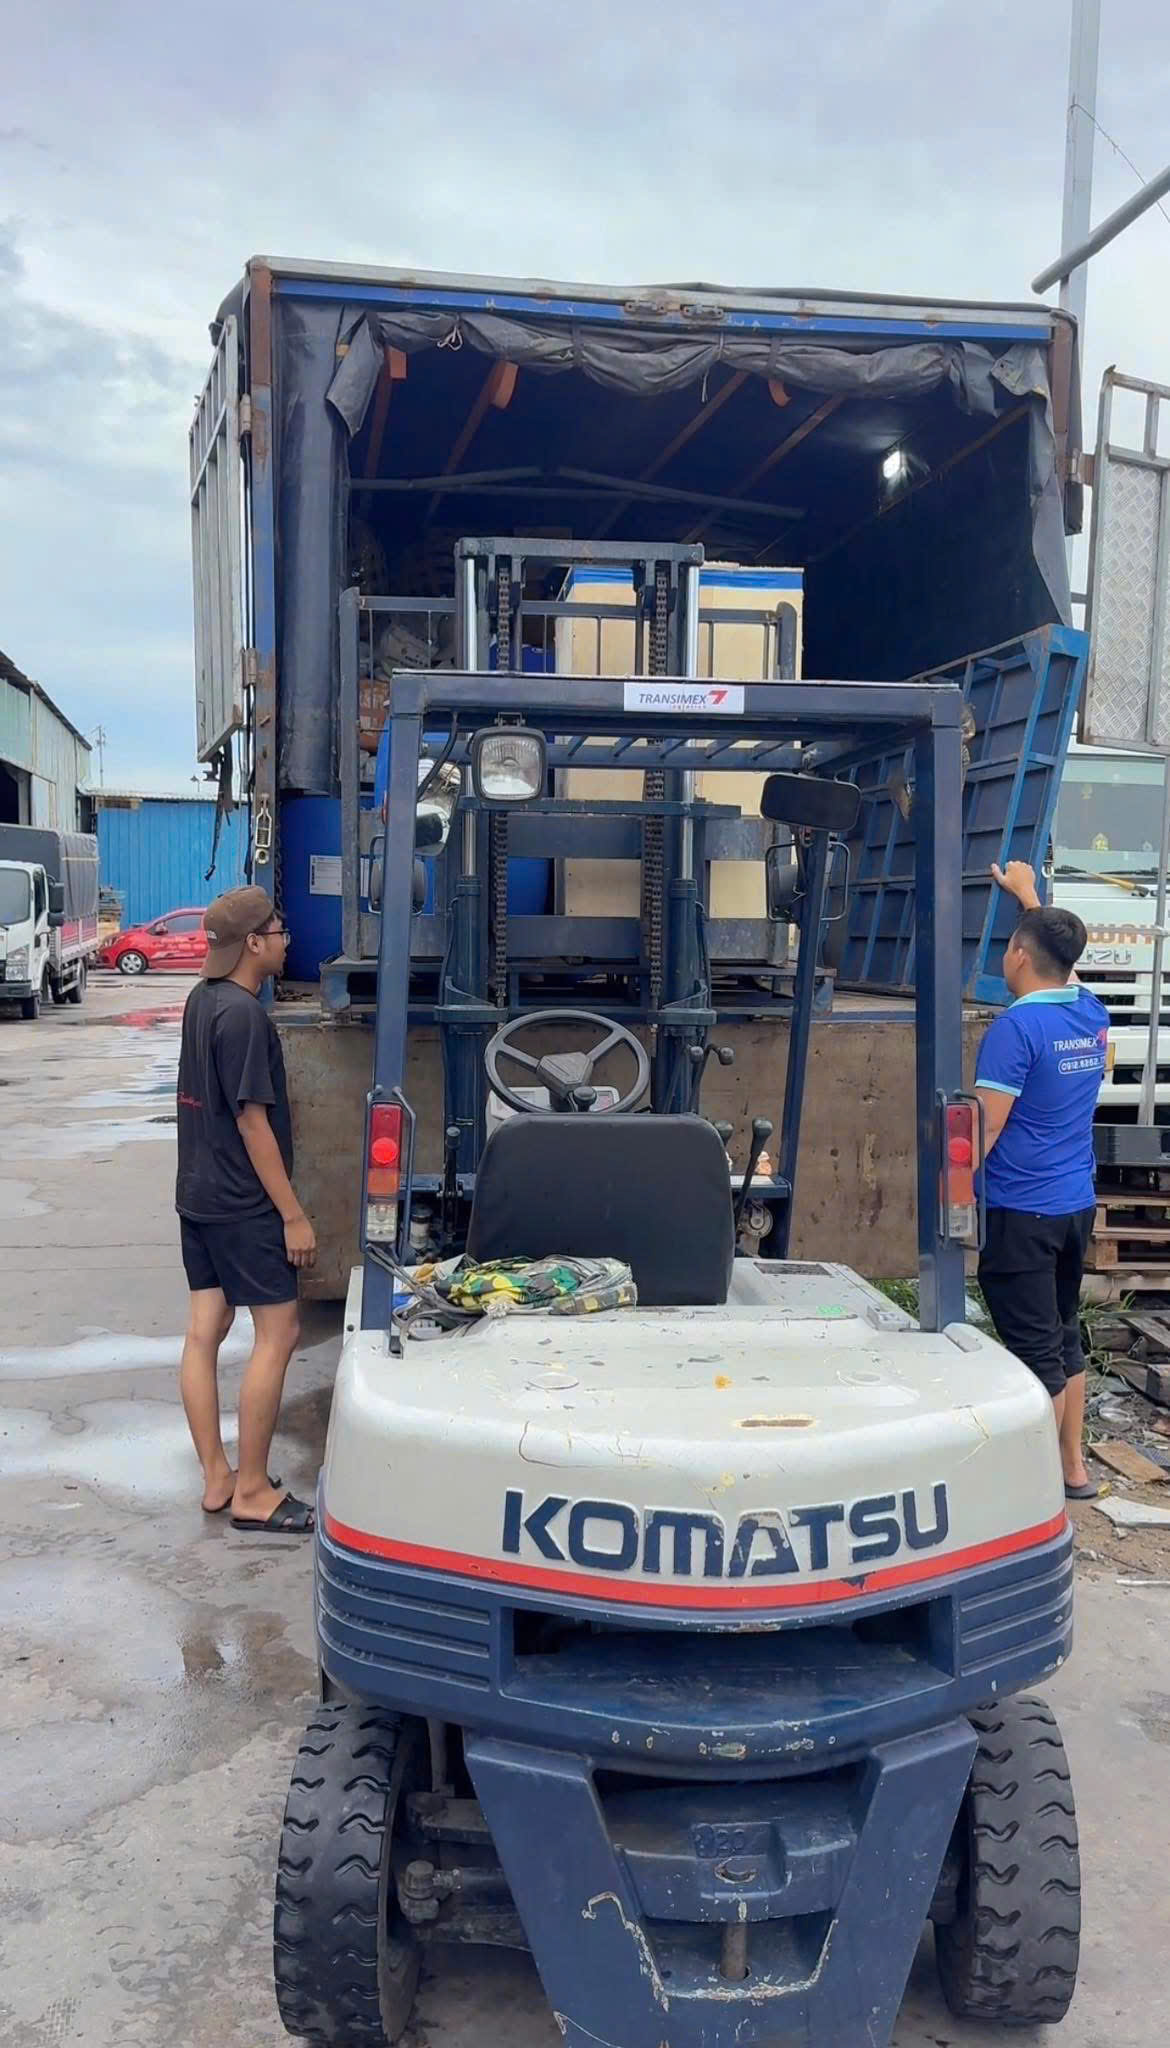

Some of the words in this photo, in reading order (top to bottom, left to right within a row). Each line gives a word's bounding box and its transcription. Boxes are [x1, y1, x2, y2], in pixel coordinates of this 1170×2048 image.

[639, 692, 707, 705] TRANSIMEX
[1077, 949, 1132, 965] UZU
[1053, 1036, 1098, 1052] TRANSIMEX
[501, 1482, 949, 1577] KOMATSU
